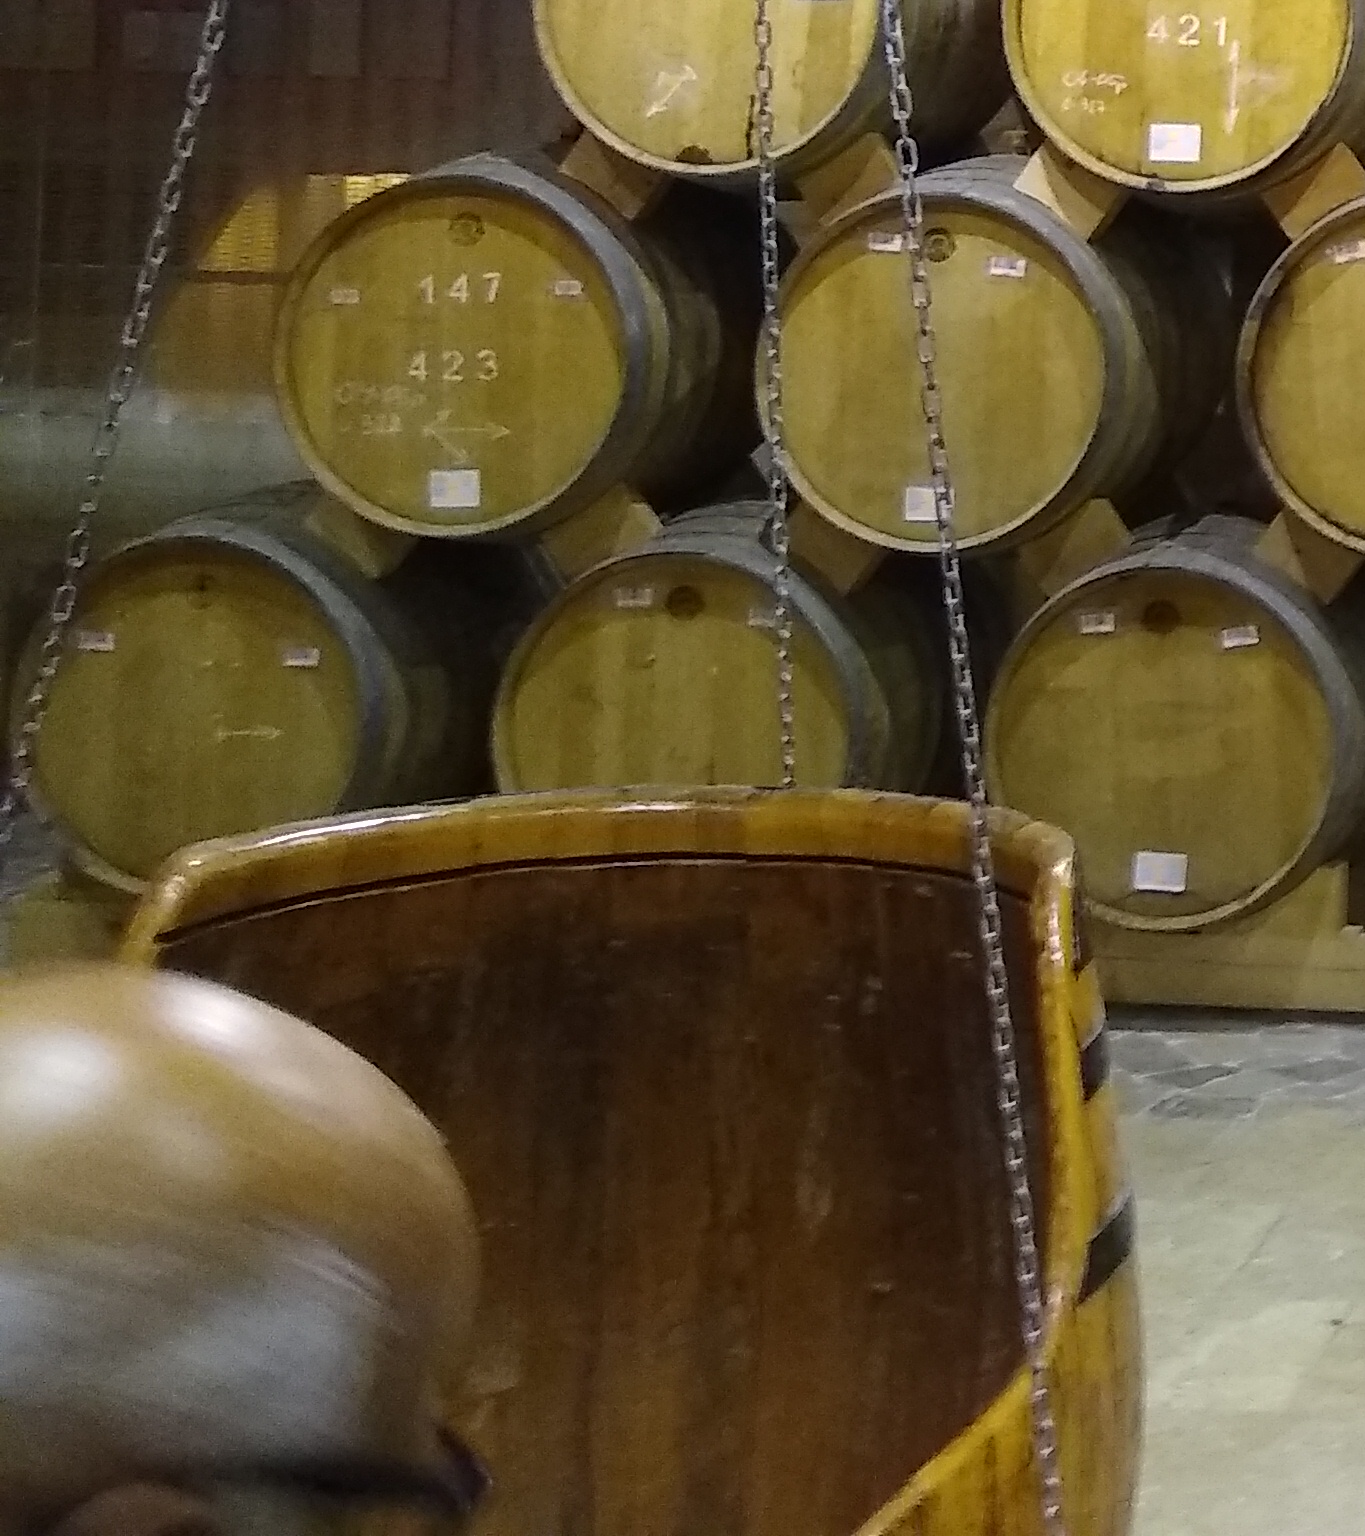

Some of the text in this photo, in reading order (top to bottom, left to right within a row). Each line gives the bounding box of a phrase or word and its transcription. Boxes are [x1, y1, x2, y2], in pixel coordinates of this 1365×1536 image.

[1147, 16, 1229, 47] 421
[417, 272, 502, 305] 147
[406, 349, 500, 382] 423
